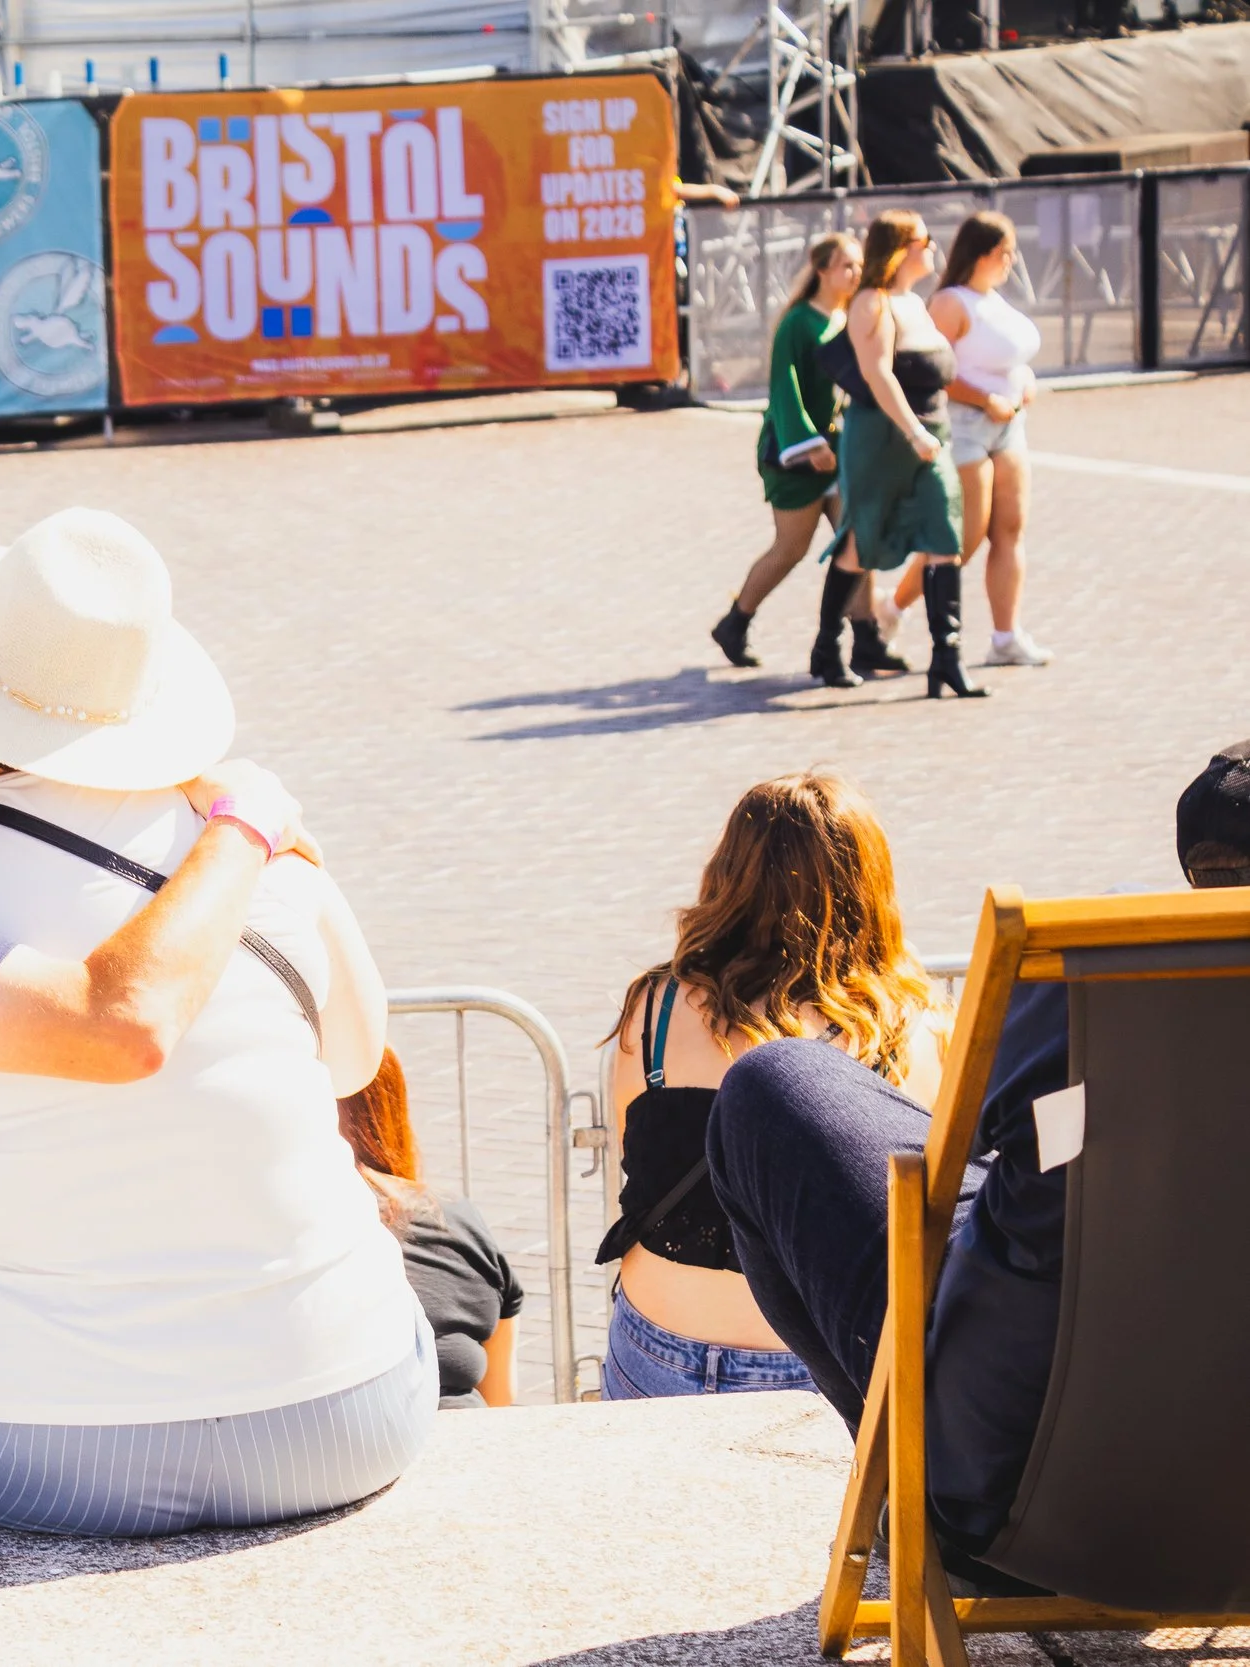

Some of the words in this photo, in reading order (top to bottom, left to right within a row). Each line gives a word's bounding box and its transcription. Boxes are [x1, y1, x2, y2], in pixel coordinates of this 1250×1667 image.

[542, 99, 601, 134] SIGN
[604, 97, 637, 132] UP
[141, 106, 485, 229] BRISTOL
[569, 134, 615, 168] FOR
[541, 169, 646, 205] UPDATES
[544, 208, 580, 242] ON
[582, 205, 645, 240] 2026
[145, 223, 490, 341] SOUNDS
